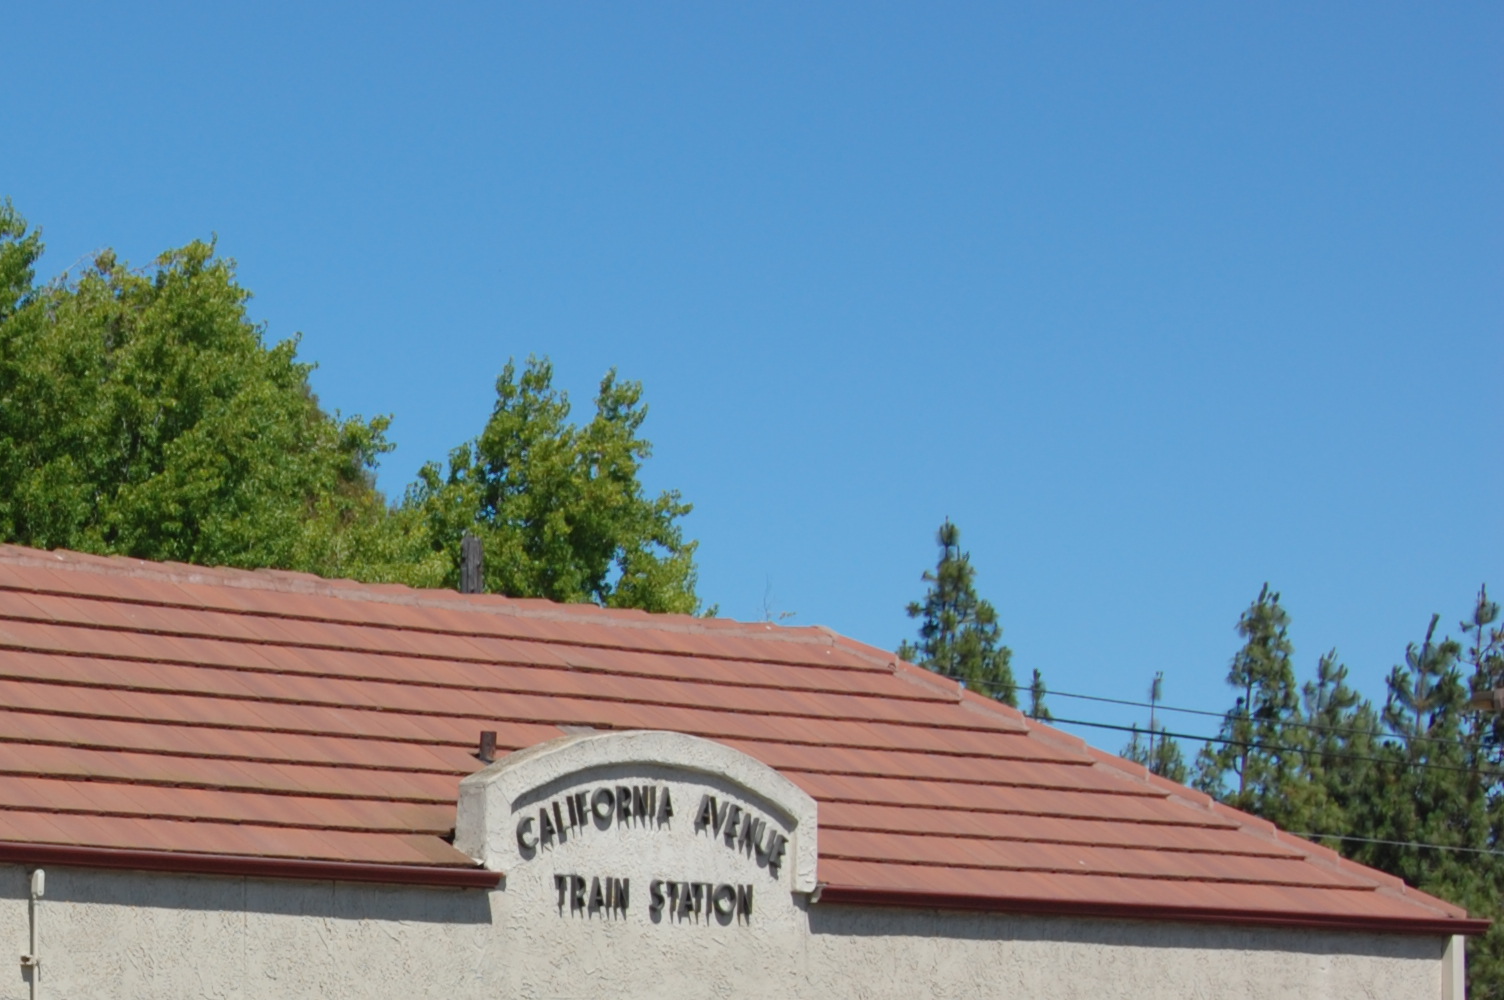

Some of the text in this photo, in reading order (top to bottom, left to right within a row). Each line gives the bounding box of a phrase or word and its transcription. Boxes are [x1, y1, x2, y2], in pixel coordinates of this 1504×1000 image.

[516, 785, 789, 869] CALIFORNIA AVENUE
[554, 874, 754, 915] TRAIN STATION
